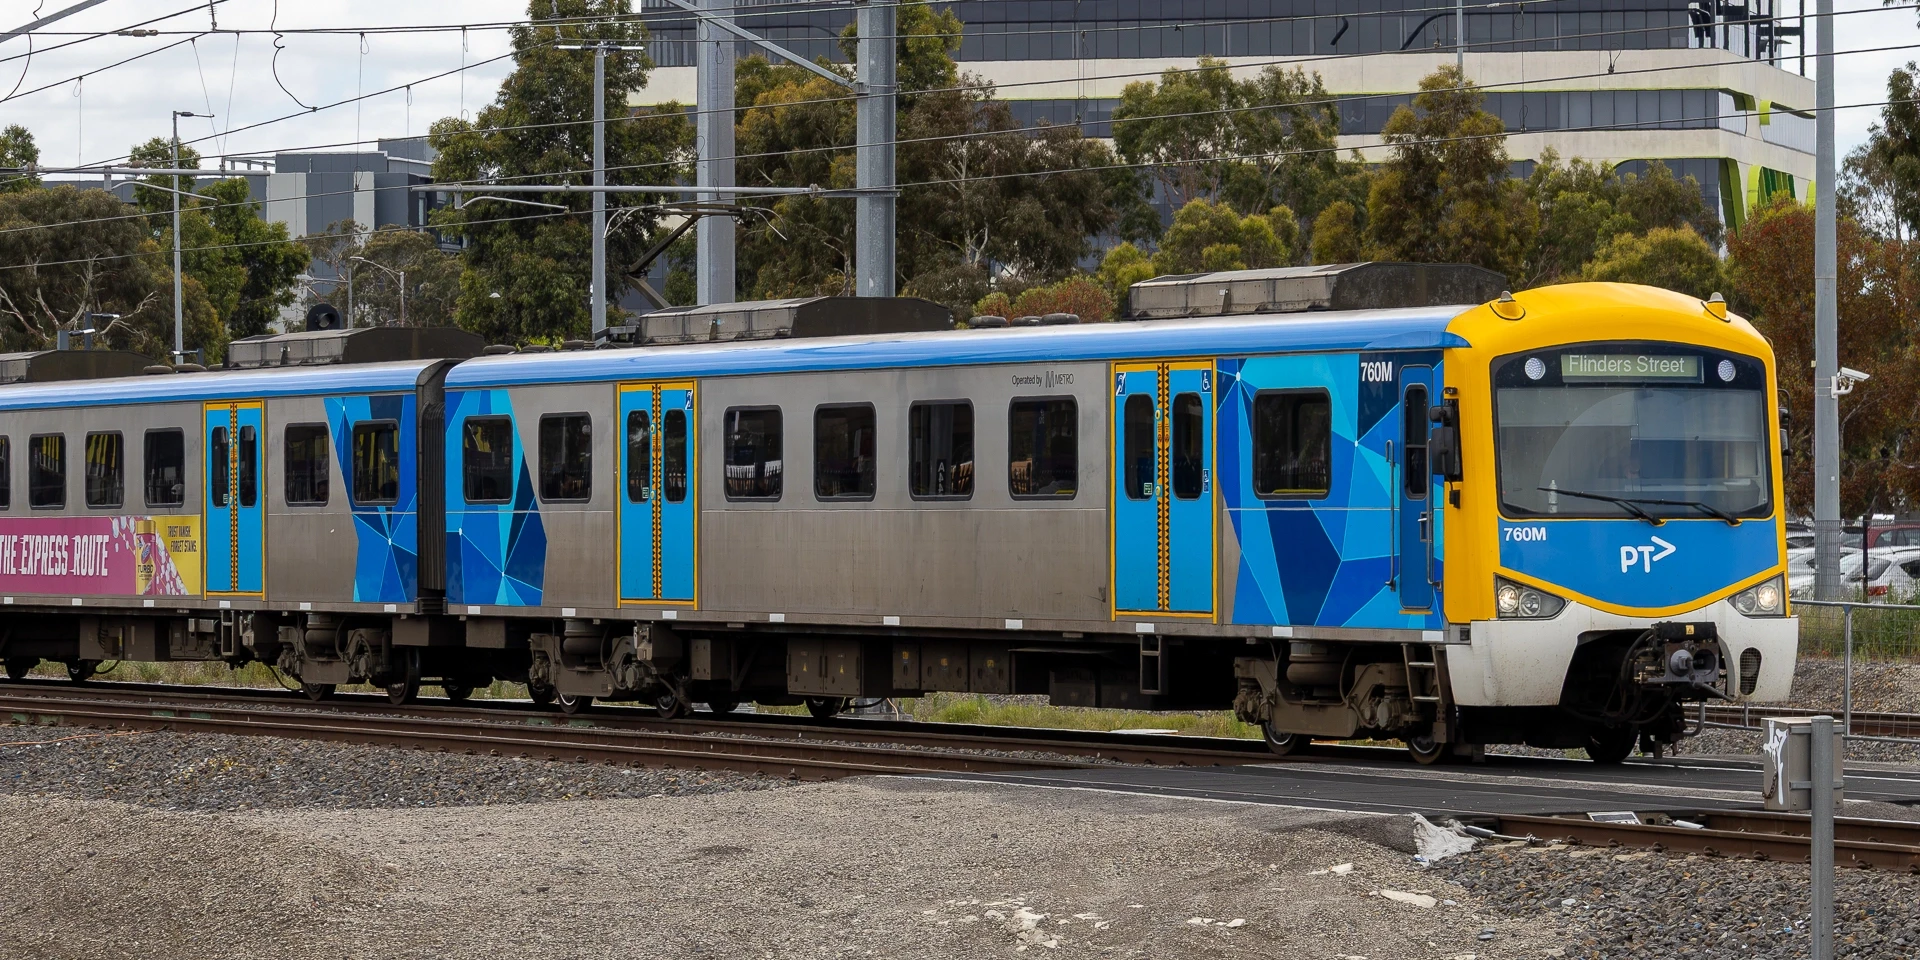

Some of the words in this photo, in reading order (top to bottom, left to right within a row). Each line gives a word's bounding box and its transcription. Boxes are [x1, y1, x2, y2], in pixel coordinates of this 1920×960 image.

[1360, 361, 1393, 382] 760M
[1569, 354, 1632, 373] Flinders
[1636, 355, 1685, 373] Street
[1012, 375, 1036, 387] Operated
[1036, 375, 1042, 387] by
[1055, 374, 1074, 385] METRO
[1503, 526, 1547, 542] 760M
[0, 534, 18, 575] THE
[18, 534, 68, 576] EXPRESS
[69, 535, 109, 576] ROUTE
